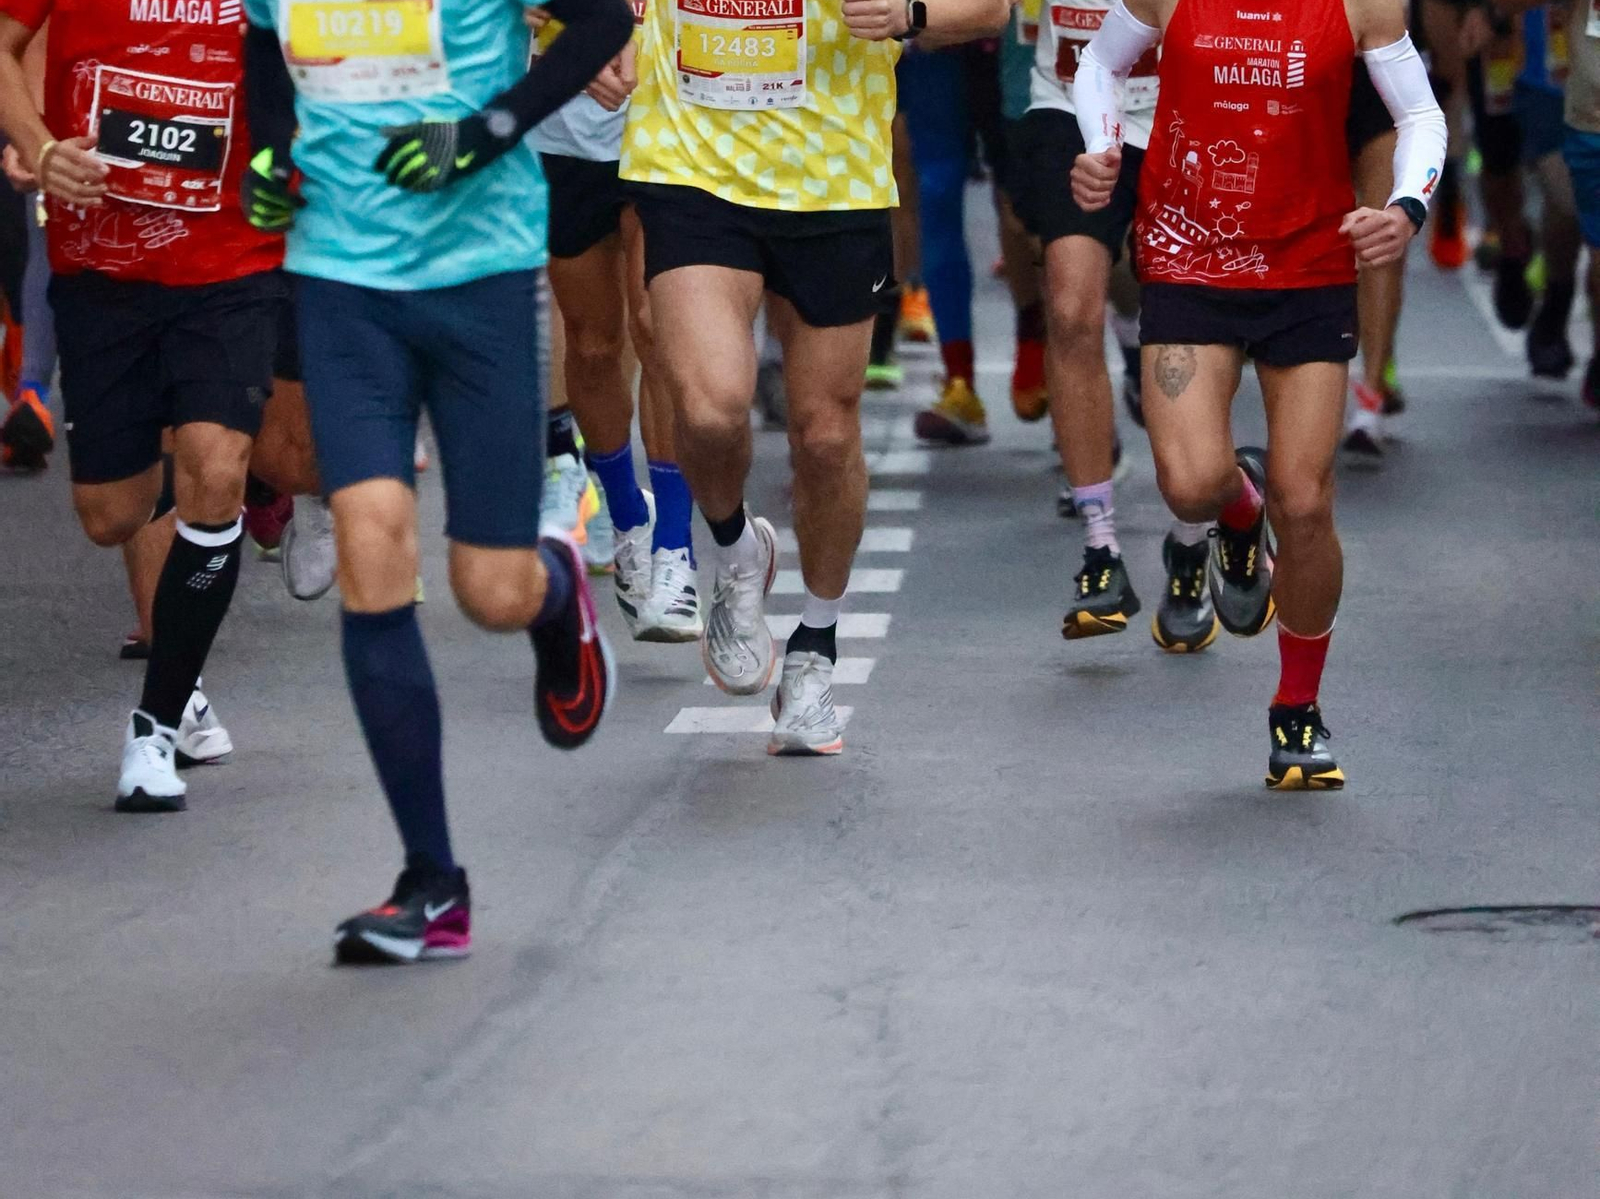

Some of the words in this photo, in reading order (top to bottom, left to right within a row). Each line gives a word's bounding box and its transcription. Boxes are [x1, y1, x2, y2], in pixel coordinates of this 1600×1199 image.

[315, 9, 404, 37] 10219
[1236, 10, 1270, 21] luanvi
[699, 33, 776, 57] 12483
[1214, 35, 1282, 53] GENERALI
[1213, 62, 1282, 88] MÁLAGA
[762, 82, 784, 91] 21K
[1213, 100, 1250, 112] málaga
[127, 120, 197, 153] 2102
